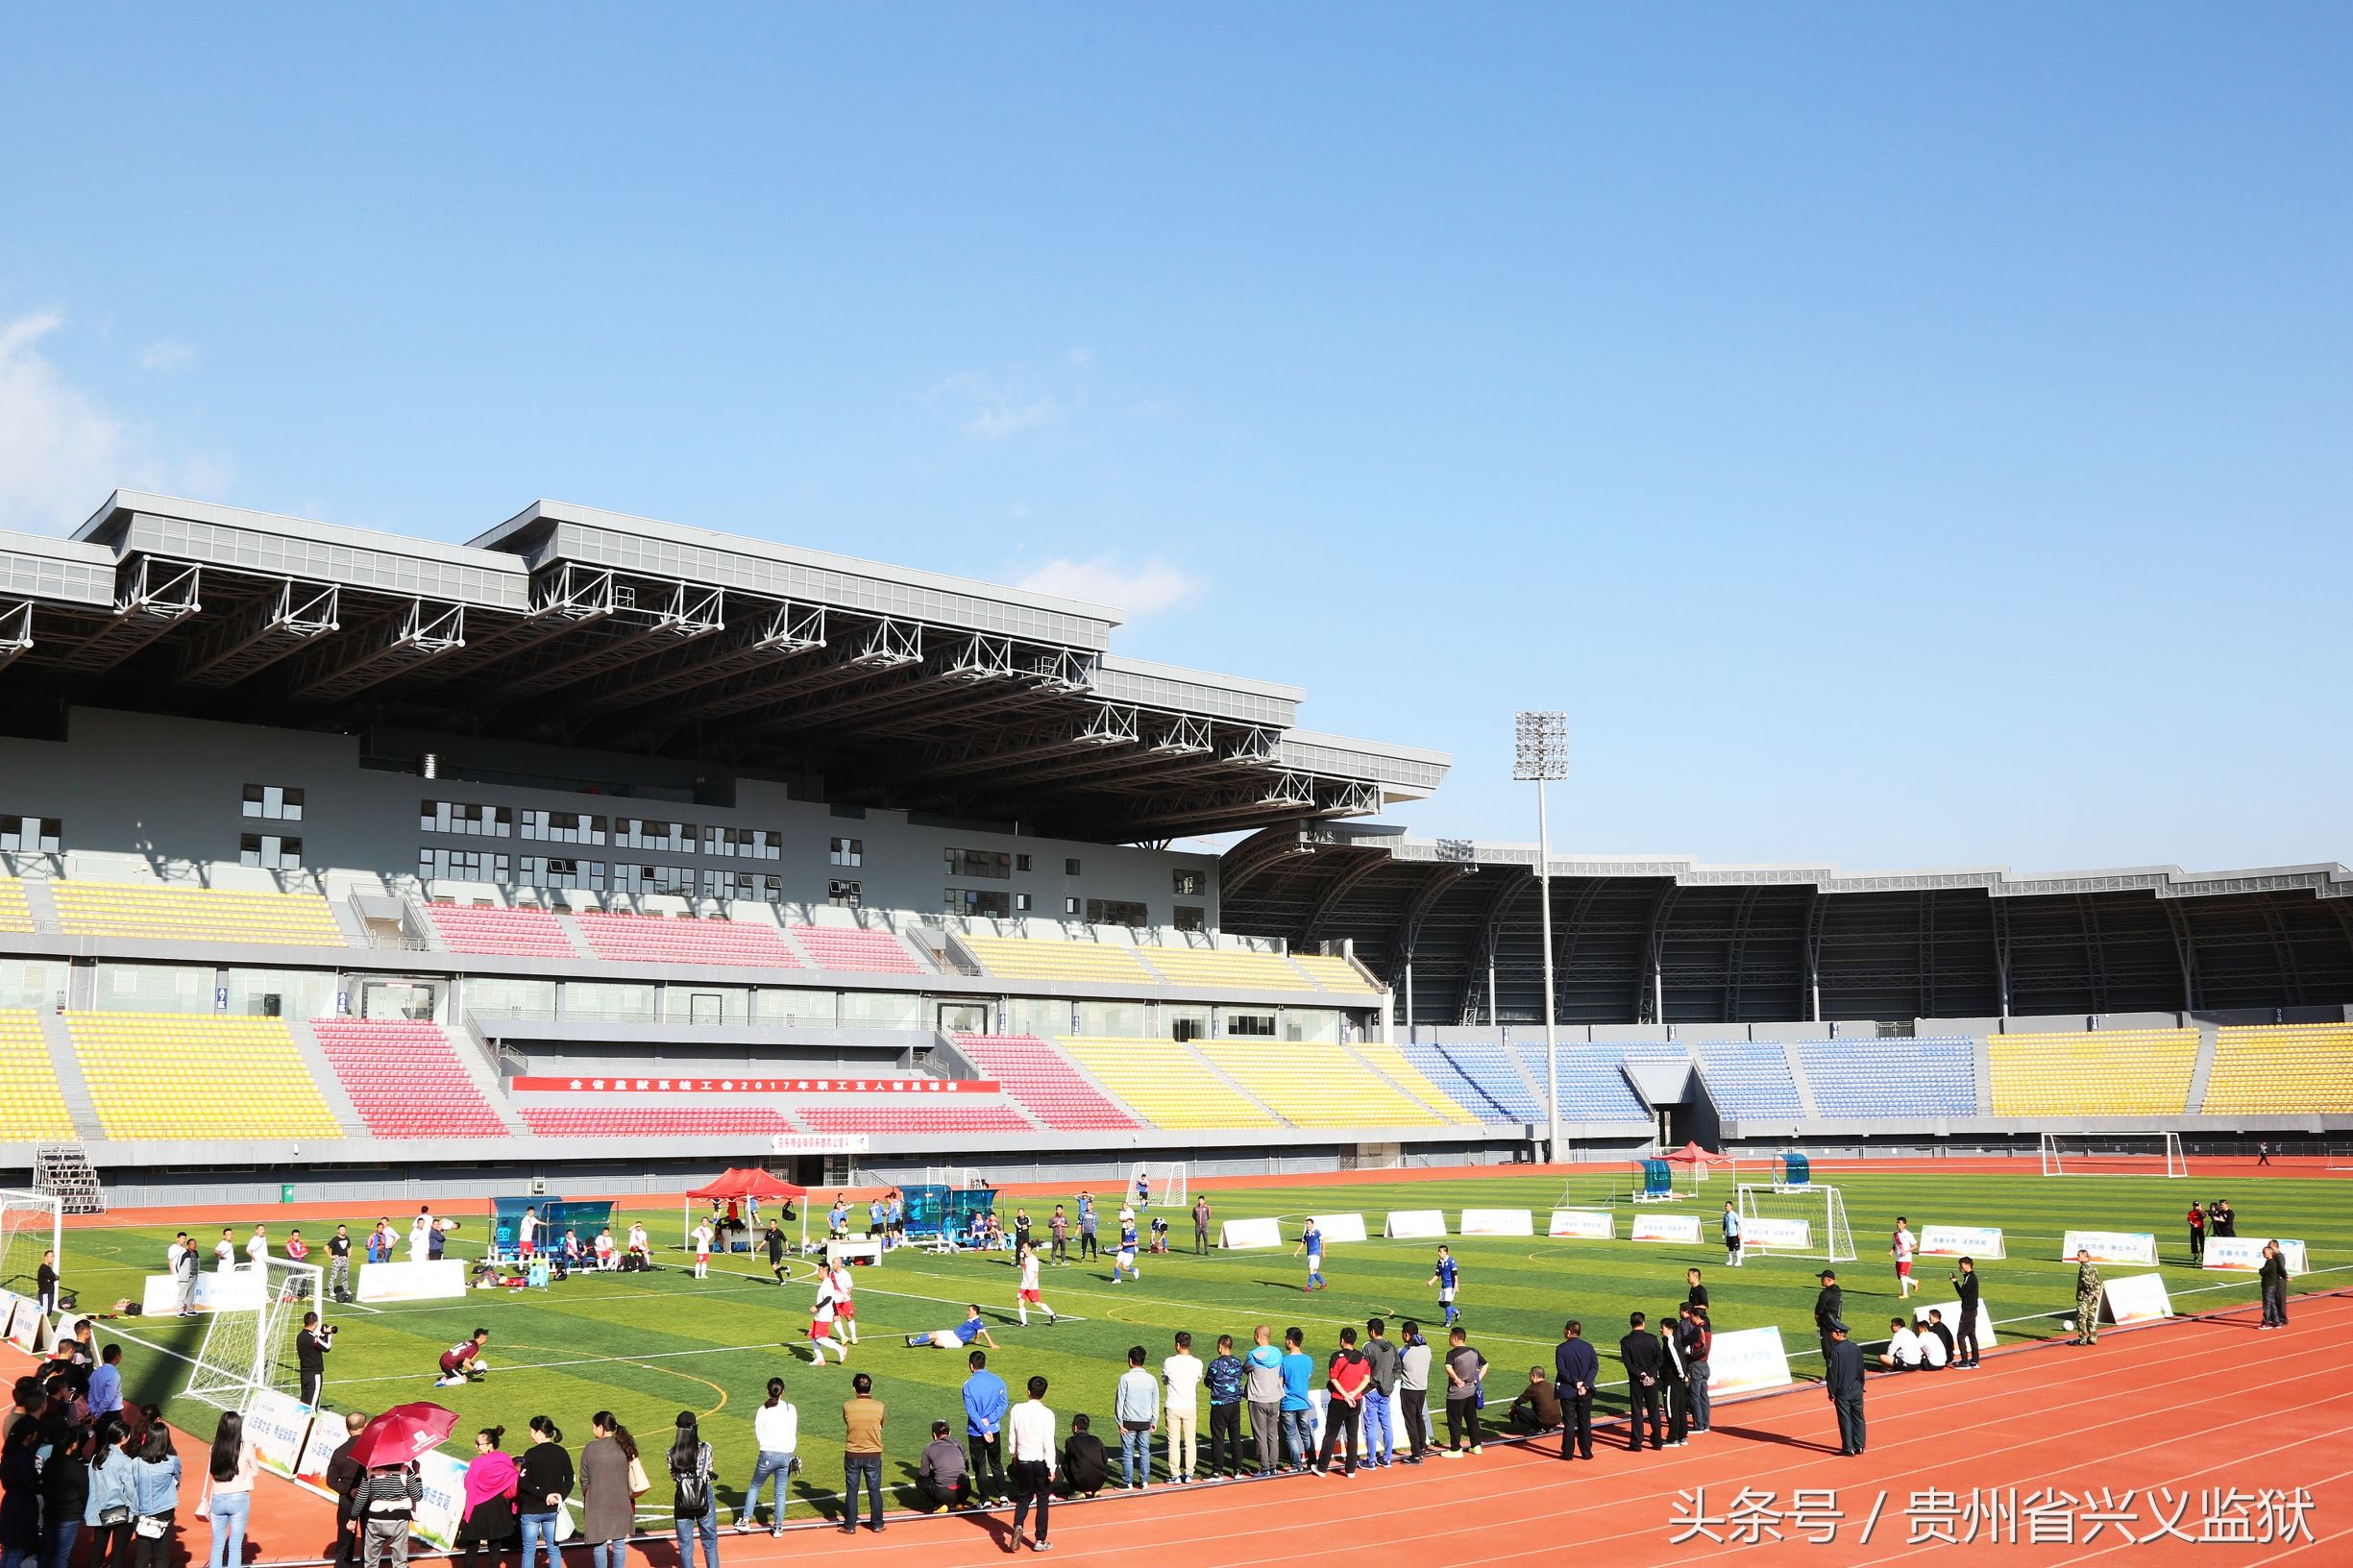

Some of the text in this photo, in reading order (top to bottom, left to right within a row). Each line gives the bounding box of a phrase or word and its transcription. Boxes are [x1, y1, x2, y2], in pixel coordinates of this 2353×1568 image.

[570, 1079, 958, 1091] 全省监狱系统工会2017年职工五人制足球赛
